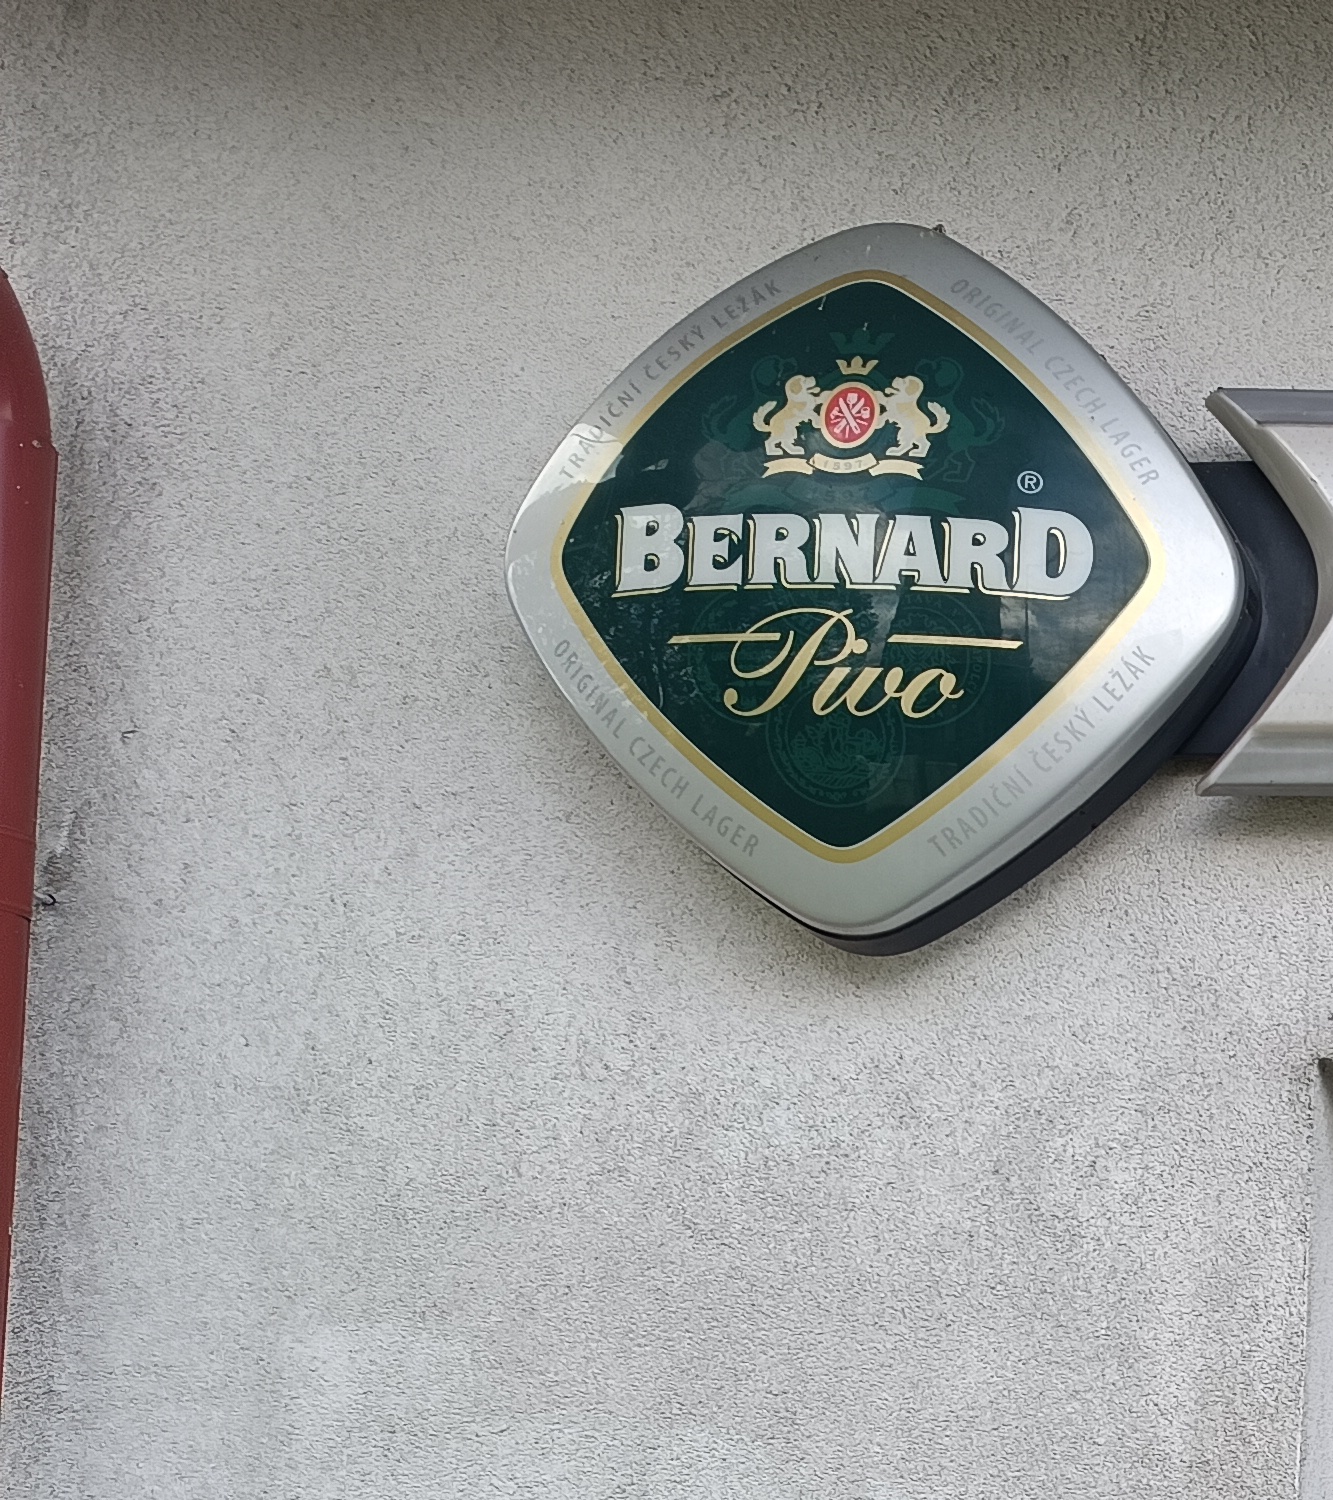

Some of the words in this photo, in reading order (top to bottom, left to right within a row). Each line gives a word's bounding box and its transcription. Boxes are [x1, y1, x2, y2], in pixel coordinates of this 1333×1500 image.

[559, 379, 642, 479] TRADIČNÍ
[643, 325, 705, 380] ČESKÝ
[711, 279, 781, 328] LEŽÁK
[823, 460, 863, 471] 1597
[950, 279, 1044, 355] ORIGINAL
[1044, 356, 1106, 415] CZECH
[1100, 417, 1160, 485] LAGER
[612, 503, 1094, 599] BERNARD
[554, 639, 627, 739] ORIGINAL
[630, 736, 690, 799] CZECH
[691, 794, 759, 857] LAGER
[724, 607, 964, 719] Pivo
[927, 764, 1033, 857] TRADIČNÍ
[1028, 705, 1095, 772] ČESKÝ
[1092, 645, 1155, 713] LEŽÁK
